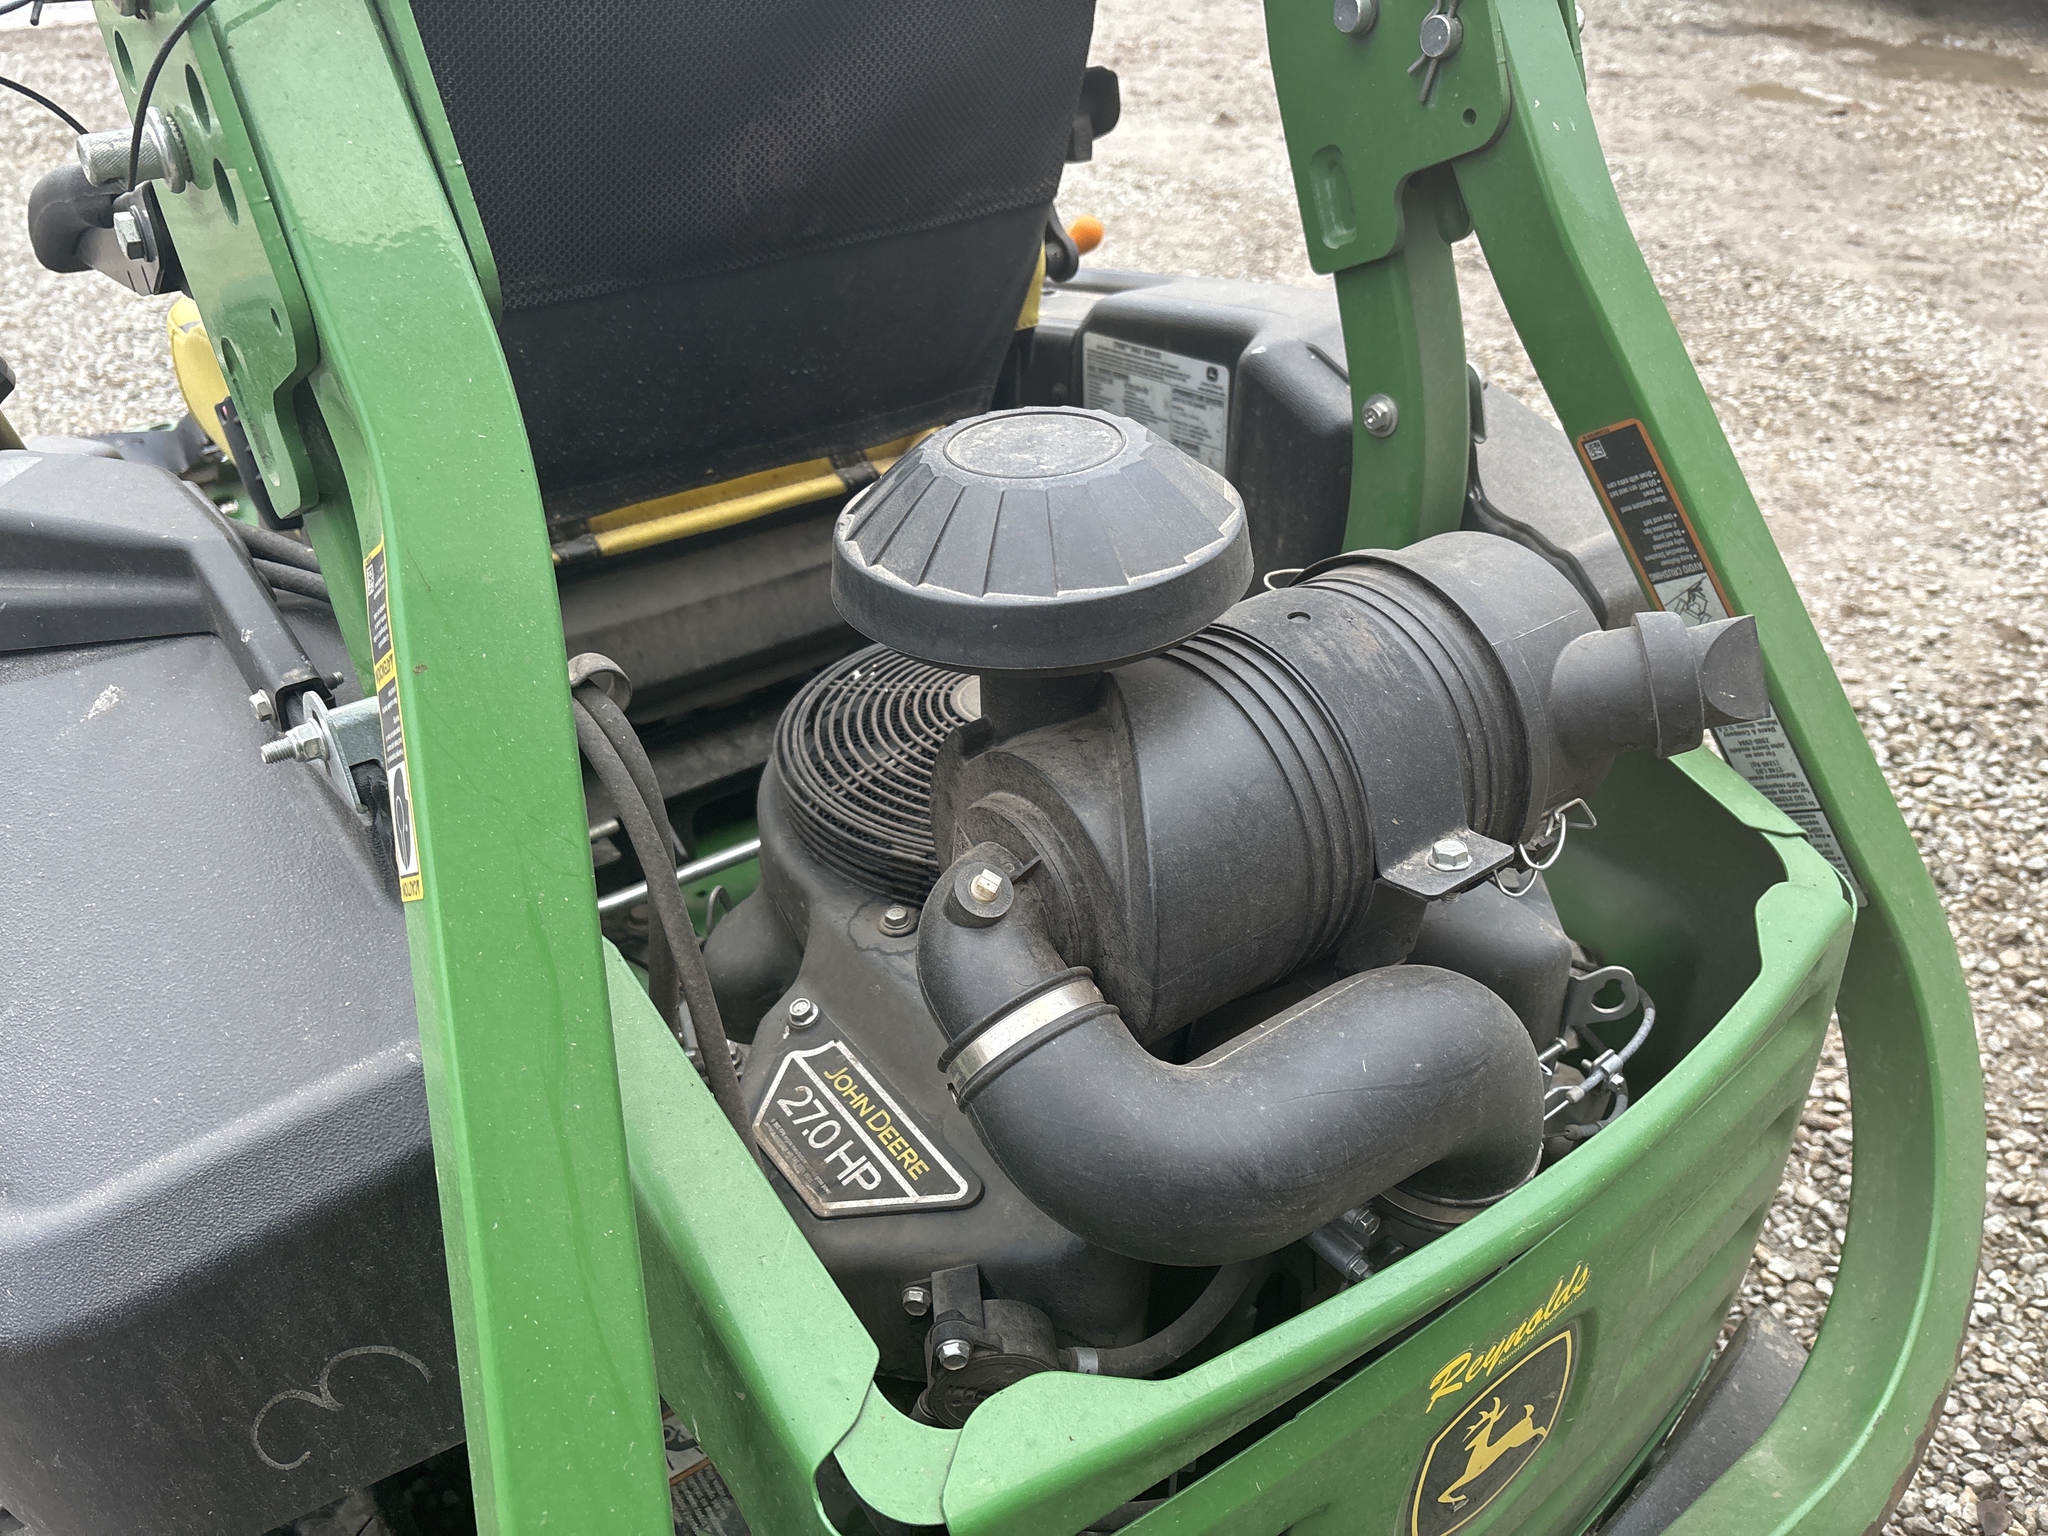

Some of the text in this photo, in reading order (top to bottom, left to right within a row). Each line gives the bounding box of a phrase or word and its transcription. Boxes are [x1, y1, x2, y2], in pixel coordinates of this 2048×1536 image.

[1639, 470, 1653, 479] Drive
[1638, 482, 1649, 490] NOT
[1648, 479, 1657, 487] DO
[1609, 490, 1619, 498] belt
[1618, 487, 1629, 495] seat
[1642, 489, 1656, 497] down
[1620, 495, 1667, 513] When structure must
[1652, 516, 1663, 524] seat
[1652, 523, 1672, 532] machine
[1653, 533, 1665, 541] jump
[1652, 540, 1674, 551] extended
[1644, 546, 1689, 561] Protective Structure
[1661, 557, 1680, 566] Rollover
[1648, 562, 1703, 582] AVOID CRUSHING
[824, 1066, 930, 1181] JOHN DEERE
[777, 1085, 882, 1192] 27.0 HP
[1425, 1262, 1591, 1414] Reynolds
